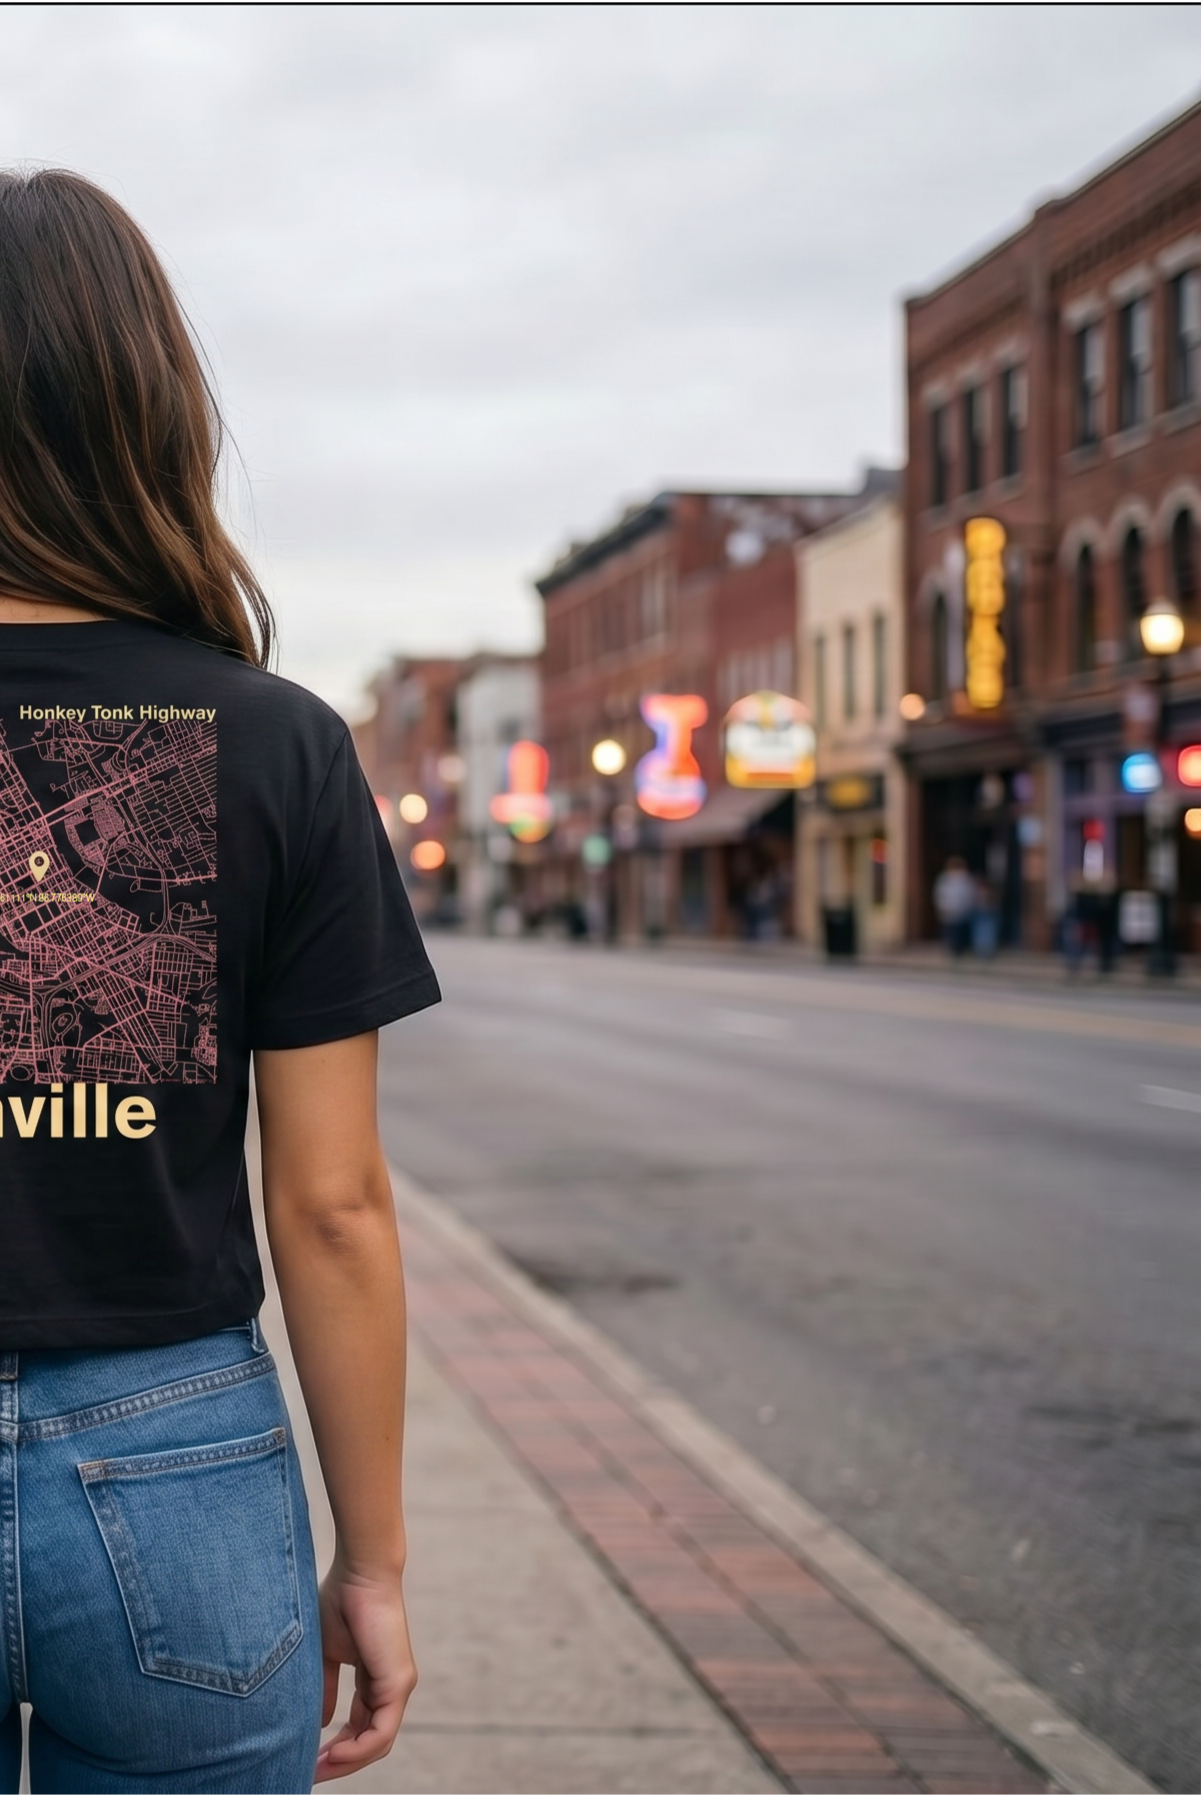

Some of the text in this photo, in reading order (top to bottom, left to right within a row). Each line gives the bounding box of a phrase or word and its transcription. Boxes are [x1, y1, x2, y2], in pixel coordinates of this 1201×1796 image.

[19, 705, 217, 723] Honkey Tonk Highway
